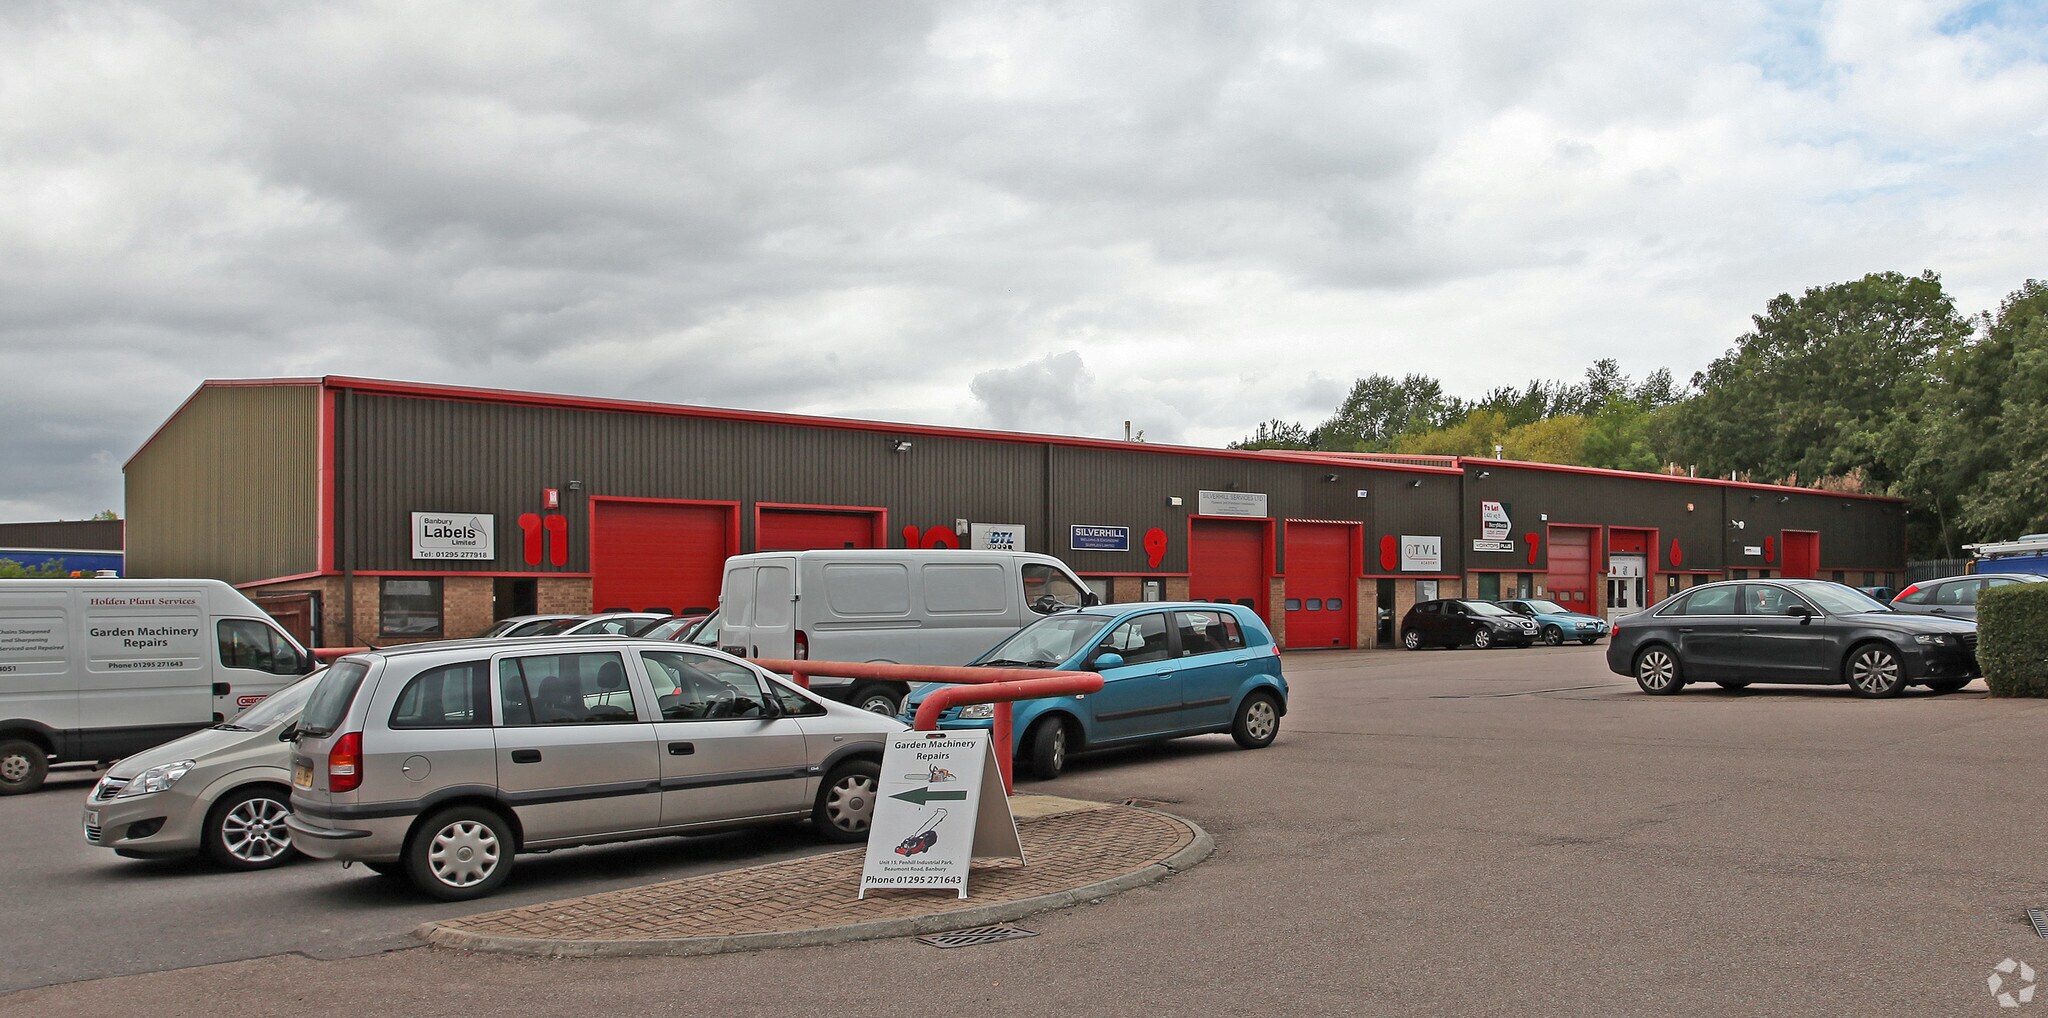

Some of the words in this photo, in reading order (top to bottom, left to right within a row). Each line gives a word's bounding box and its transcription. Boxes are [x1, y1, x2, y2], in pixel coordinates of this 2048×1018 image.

[424, 526, 476, 538] Labels
[1075, 528, 1125, 538] SILVERHILL
[518, 513, 568, 566] 11
[990, 532, 1014, 544] BTL
[1144, 528, 1168, 568] 9
[1380, 535, 1397, 570] 8
[1524, 533, 1539, 565] 7
[1670, 538, 1682, 566] 6
[90, 597, 126, 605] Holden
[129, 597, 155, 605] Plant
[158, 597, 196, 605] Services
[90, 628, 134, 637] Garden
[138, 626, 199, 637] Machinery
[124, 638, 168, 649] Repairs
[894, 741, 927, 749] Garden
[928, 740, 976, 749] Machinery
[916, 752, 950, 761] Repairs
[866, 876, 895, 884] Phone
[896, 876, 925, 884] 01295
[926, 876, 962, 884] 271643
